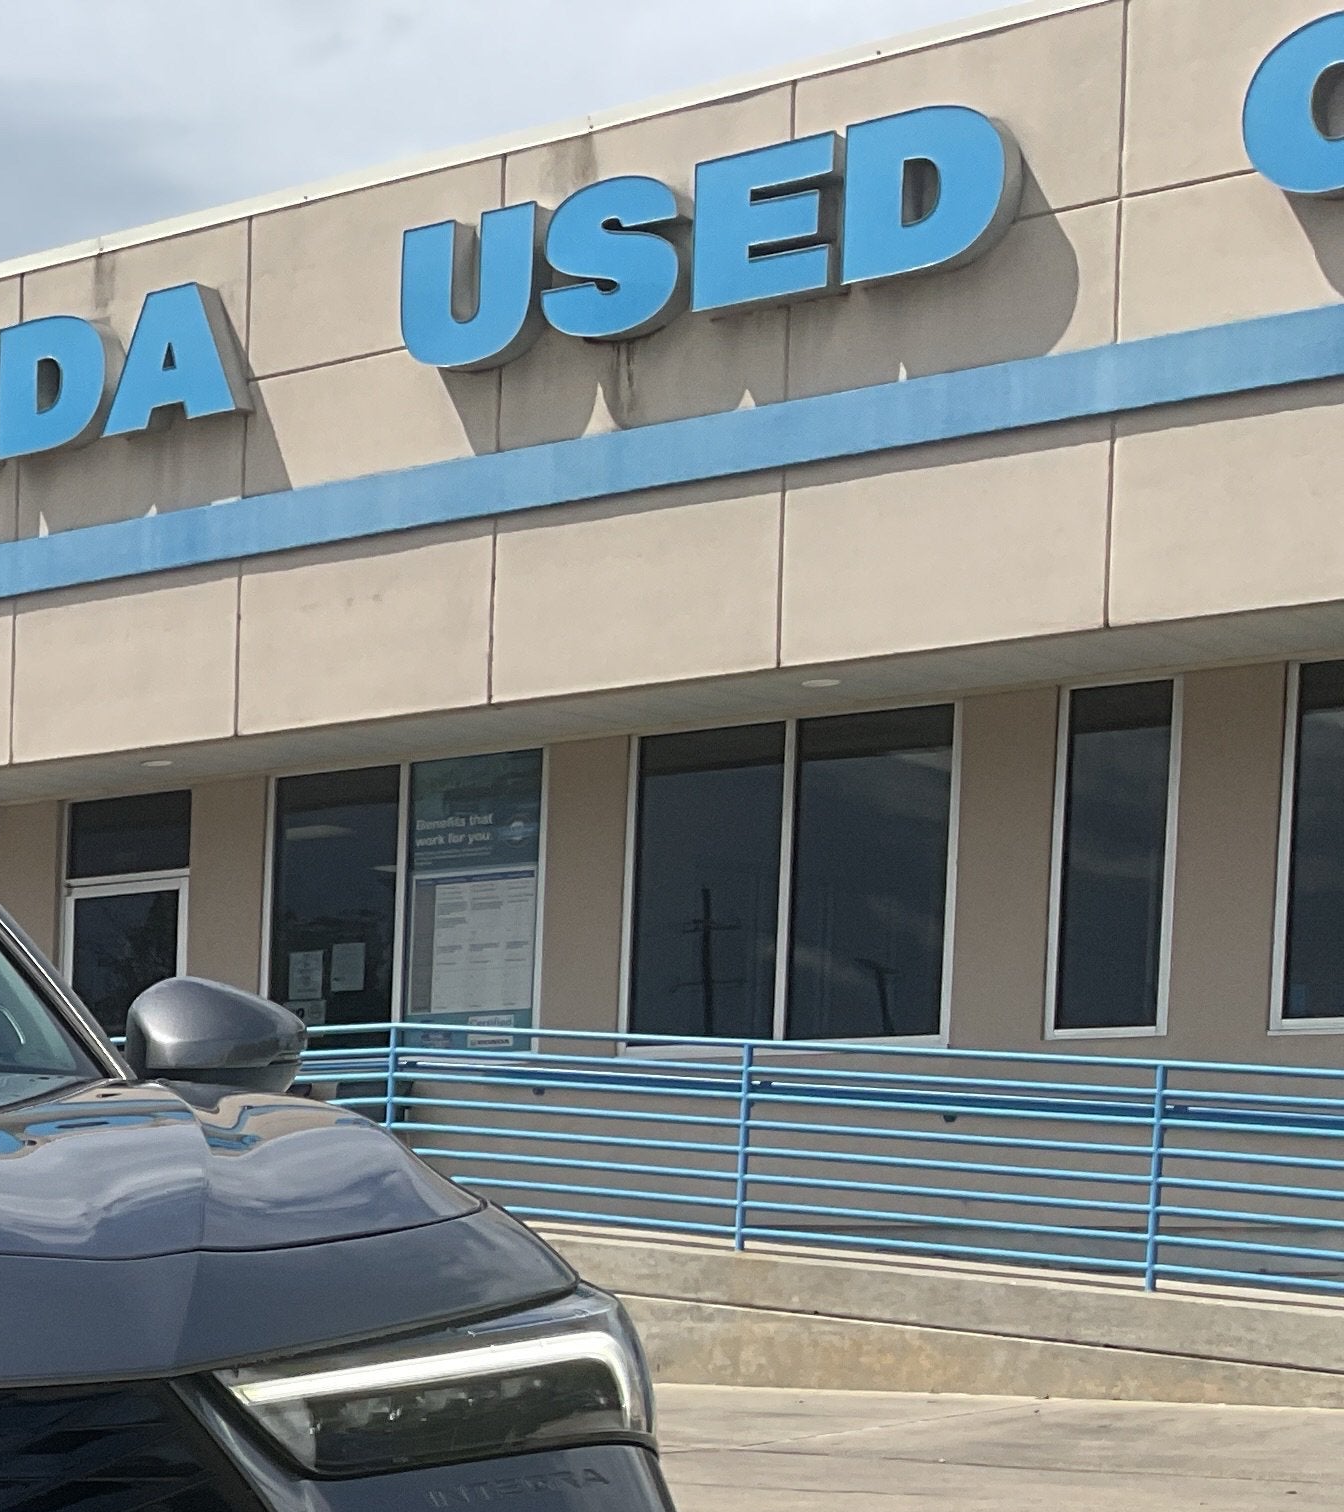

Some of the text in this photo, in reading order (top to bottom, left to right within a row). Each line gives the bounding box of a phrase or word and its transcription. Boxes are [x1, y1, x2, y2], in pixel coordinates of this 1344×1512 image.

[400, 105, 1006, 368] USED
[416, 812, 494, 831] Benefits that
[415, 832, 490, 847] work for you
